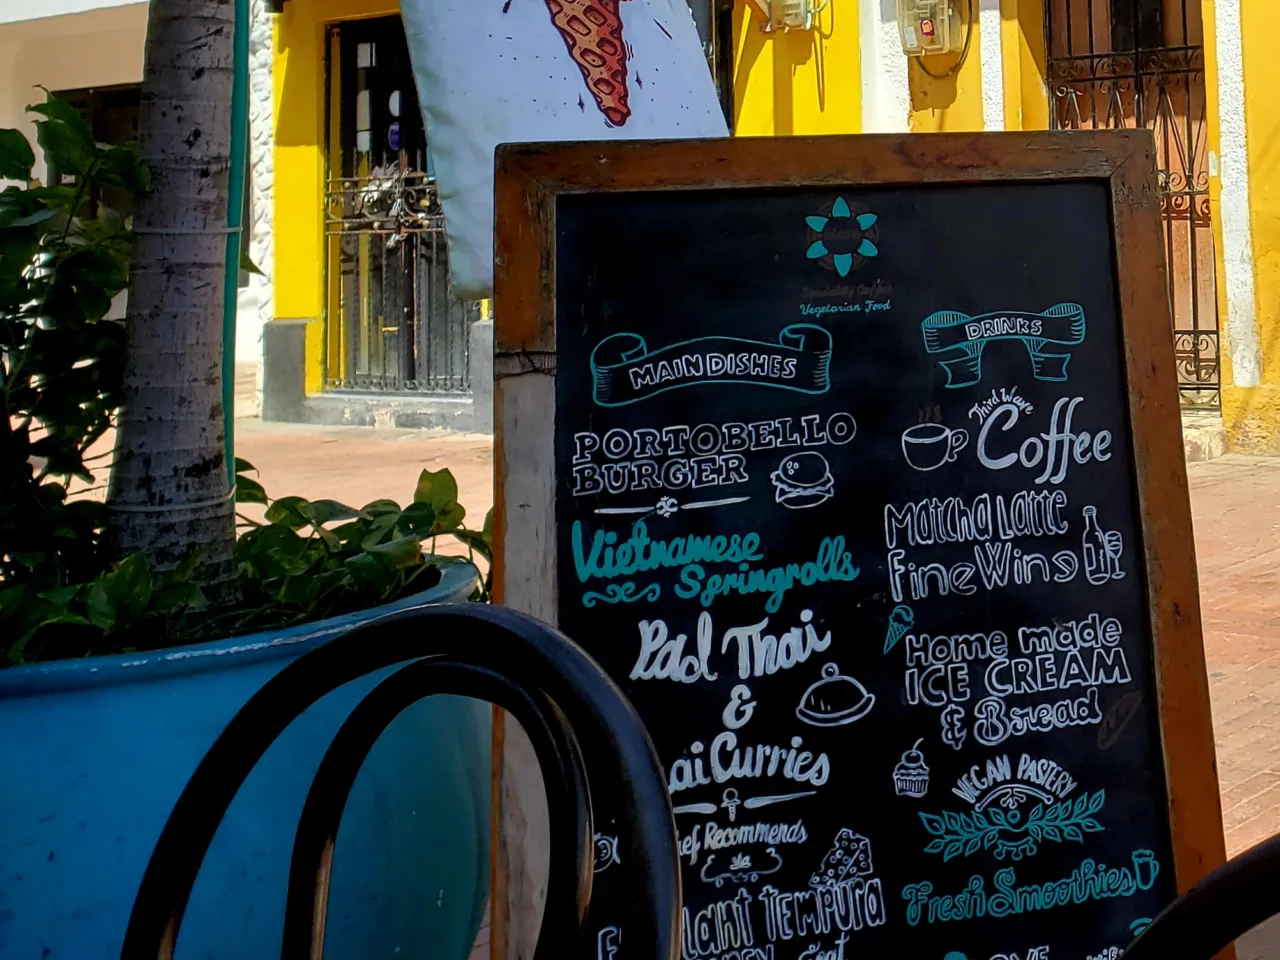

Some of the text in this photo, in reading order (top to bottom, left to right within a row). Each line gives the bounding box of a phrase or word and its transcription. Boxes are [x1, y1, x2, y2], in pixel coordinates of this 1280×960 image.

[800, 299, 891, 318] Vegetarian Food
[965, 317, 1043, 340] DRINKS
[629, 352, 798, 390] MAIN DISHES
[968, 385, 1035, 426] Third Wave
[572, 412, 857, 464] PORTOBELLO
[976, 396, 1112, 485] Coffee
[572, 453, 749, 496] BURGER
[571, 520, 764, 583] Vietnamese
[887, 548, 977, 603] Fine
[629, 608, 832, 684] Pad Thai
[905, 613, 1123, 667] Home made
[904, 647, 1132, 707] ICE CREAM
[722, 684, 757, 730] &
[973, 687, 1103, 746] Bread
[710, 731, 831, 787] Curries
[951, 753, 1078, 804] VEGAN PASTERY
[703, 818, 809, 851] Recommends
[902, 857, 1137, 927] Fresh Smoothies
